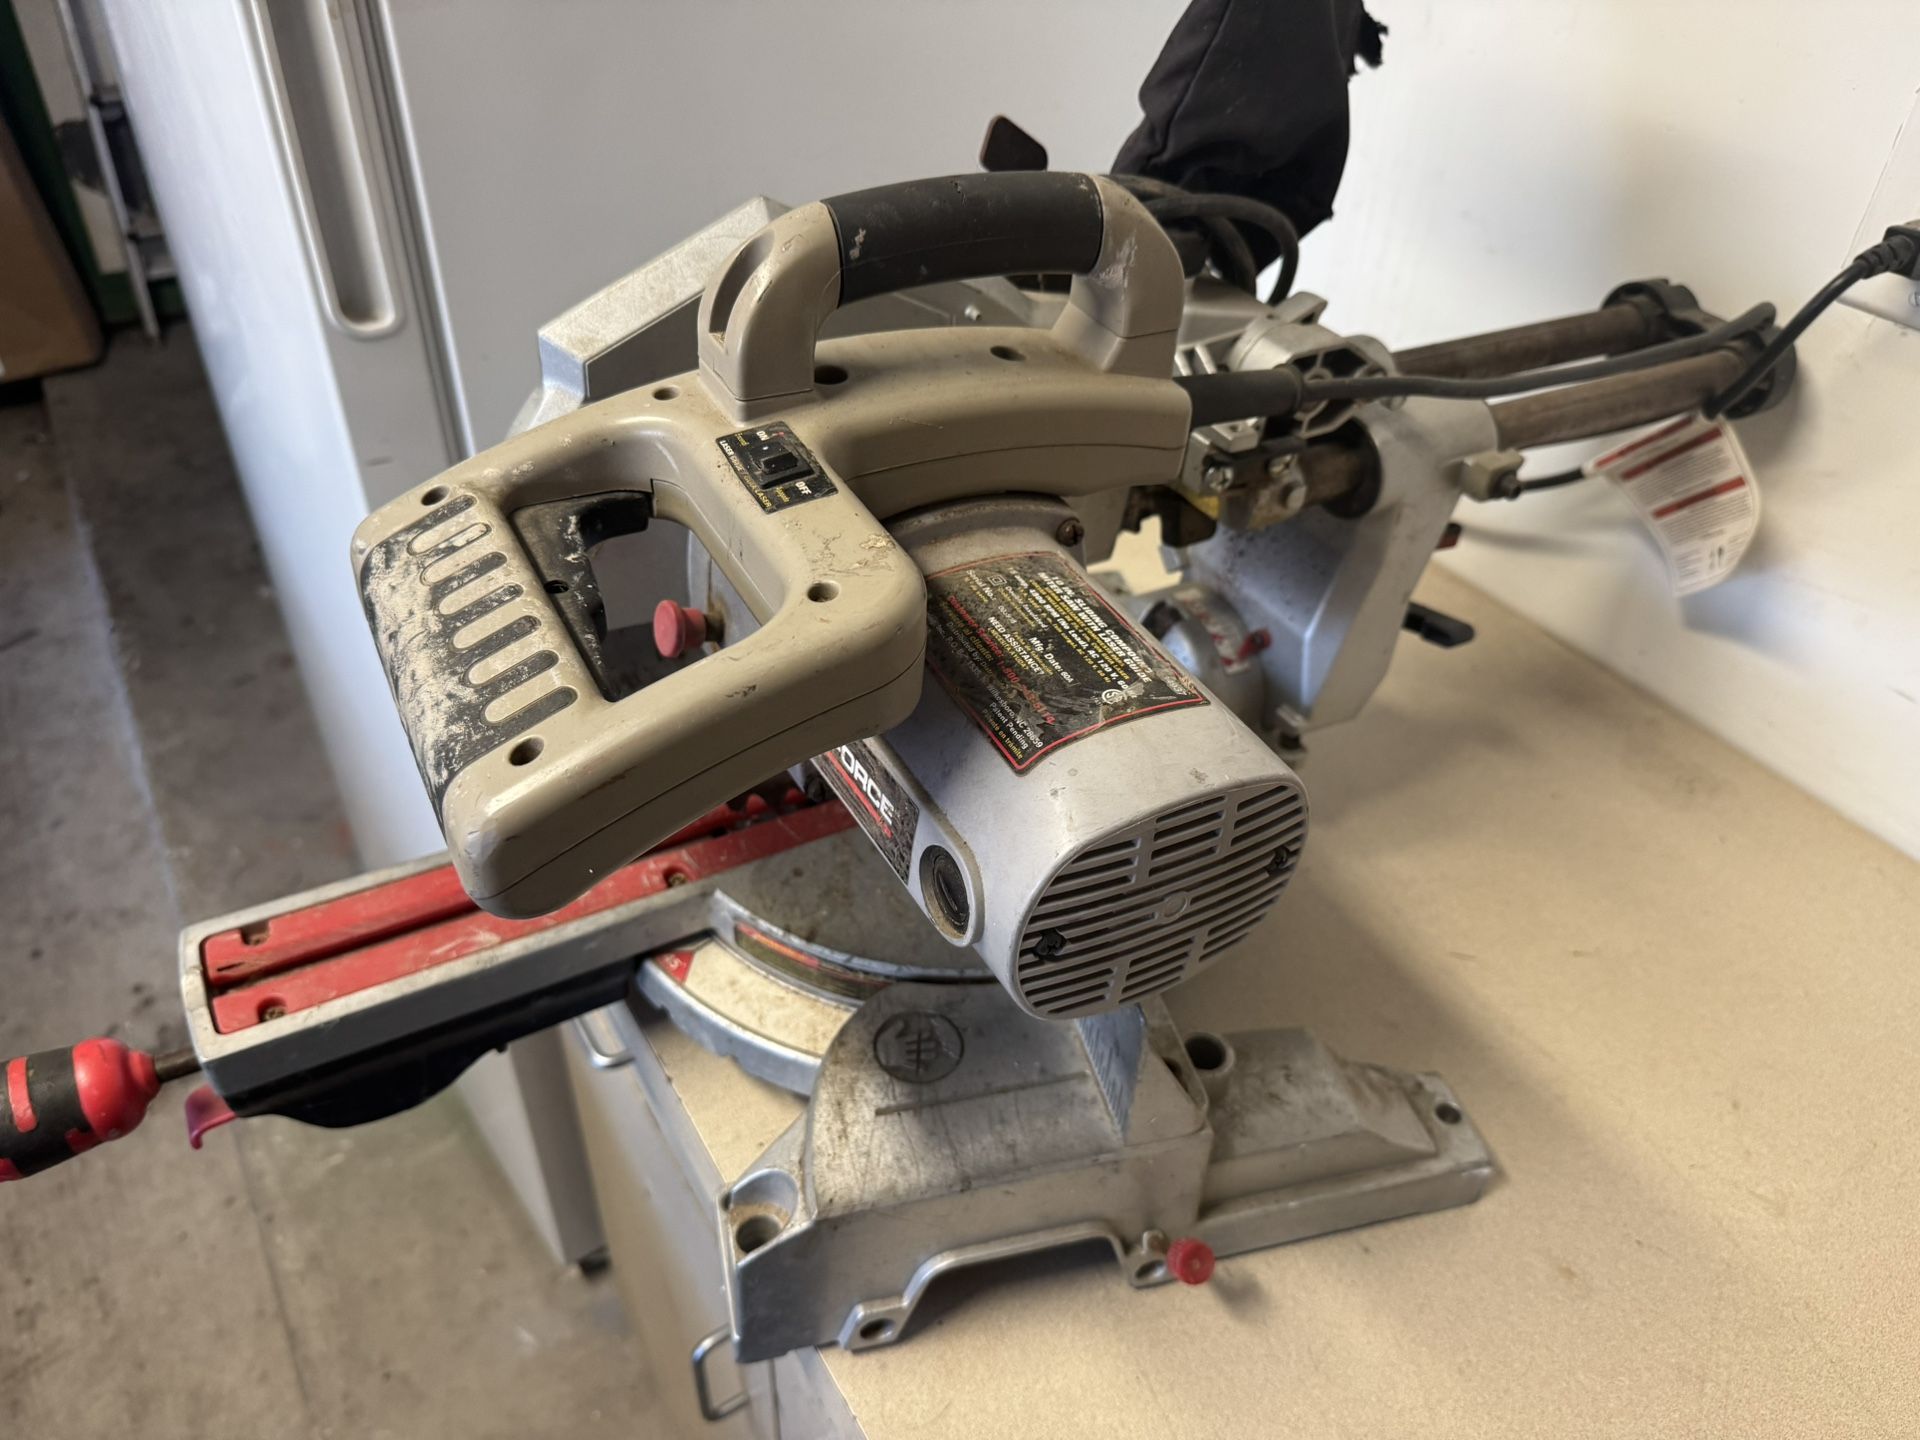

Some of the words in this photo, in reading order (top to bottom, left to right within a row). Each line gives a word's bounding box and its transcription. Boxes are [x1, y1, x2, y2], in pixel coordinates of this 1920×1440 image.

[756, 430, 770, 441] ON
[719, 440, 735, 457] LASER
[755, 489, 773, 508] LASER
[795, 481, 813, 495] OFF
[964, 568, 987, 587] Serial
[1049, 575, 1067, 586] 10
[1059, 585, 1078, 597] IN.
[1072, 597, 1109, 628] SLIDING
[944, 595, 980, 628] Customer
[974, 627, 1005, 658] Service:
[985, 615, 1008, 634] NEED
[1001, 632, 1045, 676] ASSISTANCE?
[1035, 571, 1065, 594] MITER
[1058, 593, 1082, 612] SAW
[1075, 611, 1101, 631] WITH
[1096, 632, 1127, 658] LASER
[1122, 657, 1153, 683] GUIDE
[1041, 603, 1061, 618] RPM
[1055, 617, 1072, 630] (No
[1086, 649, 1100, 659] AC
[1095, 658, 1113, 672] 120
[1107, 671, 1120, 680] V,
[1115, 679, 1129, 689] 60
[968, 651, 984, 662] by:
[1025, 636, 1049, 654] Mfg.
[1042, 652, 1066, 672] Date:
[987, 701, 1010, 724] Patent
[1004, 722, 1031, 750] Pending
[1013, 717, 1027, 729] NC
[1022, 726, 1045, 748] 28659
[836, 744, 895, 827] ORCE
